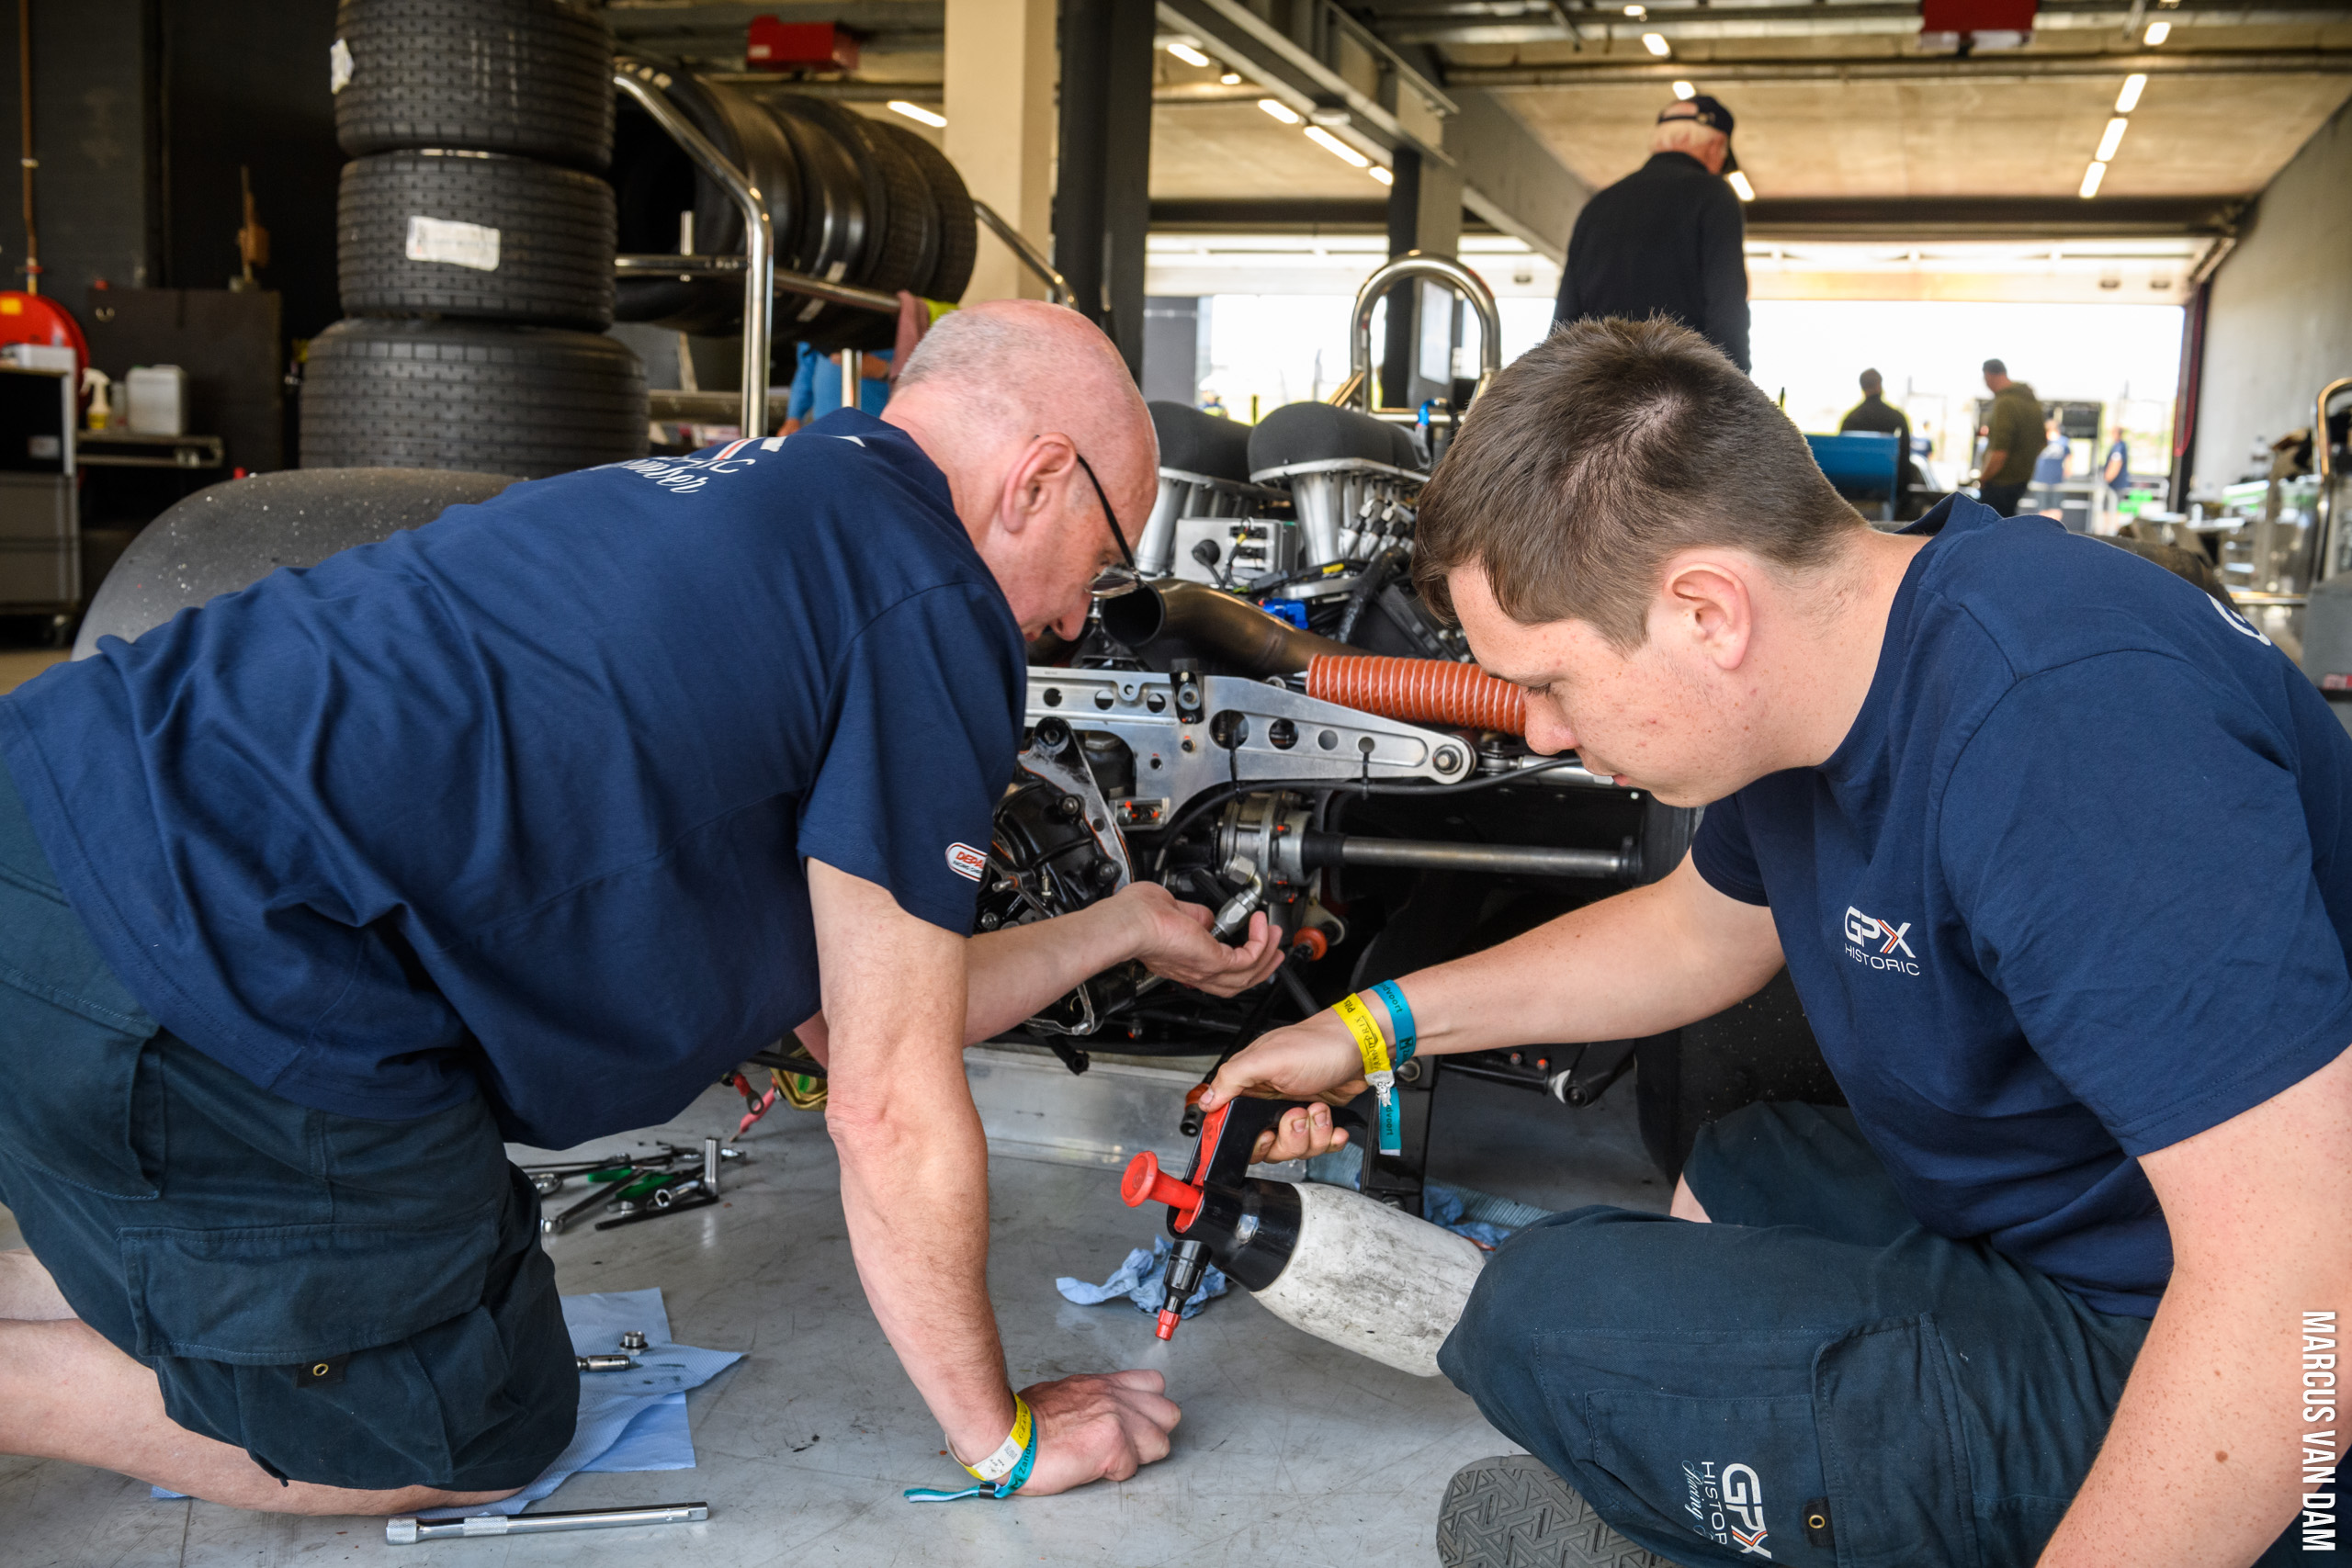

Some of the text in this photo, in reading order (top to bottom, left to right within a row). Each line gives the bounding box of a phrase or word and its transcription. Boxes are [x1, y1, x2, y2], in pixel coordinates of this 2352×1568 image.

[1844, 905, 1917, 959] GPX
[1844, 942, 1920, 976] HISTORIC
[1385, 1105, 1394, 1136] dvoort
[1721, 1462, 1772, 1560] GPX
